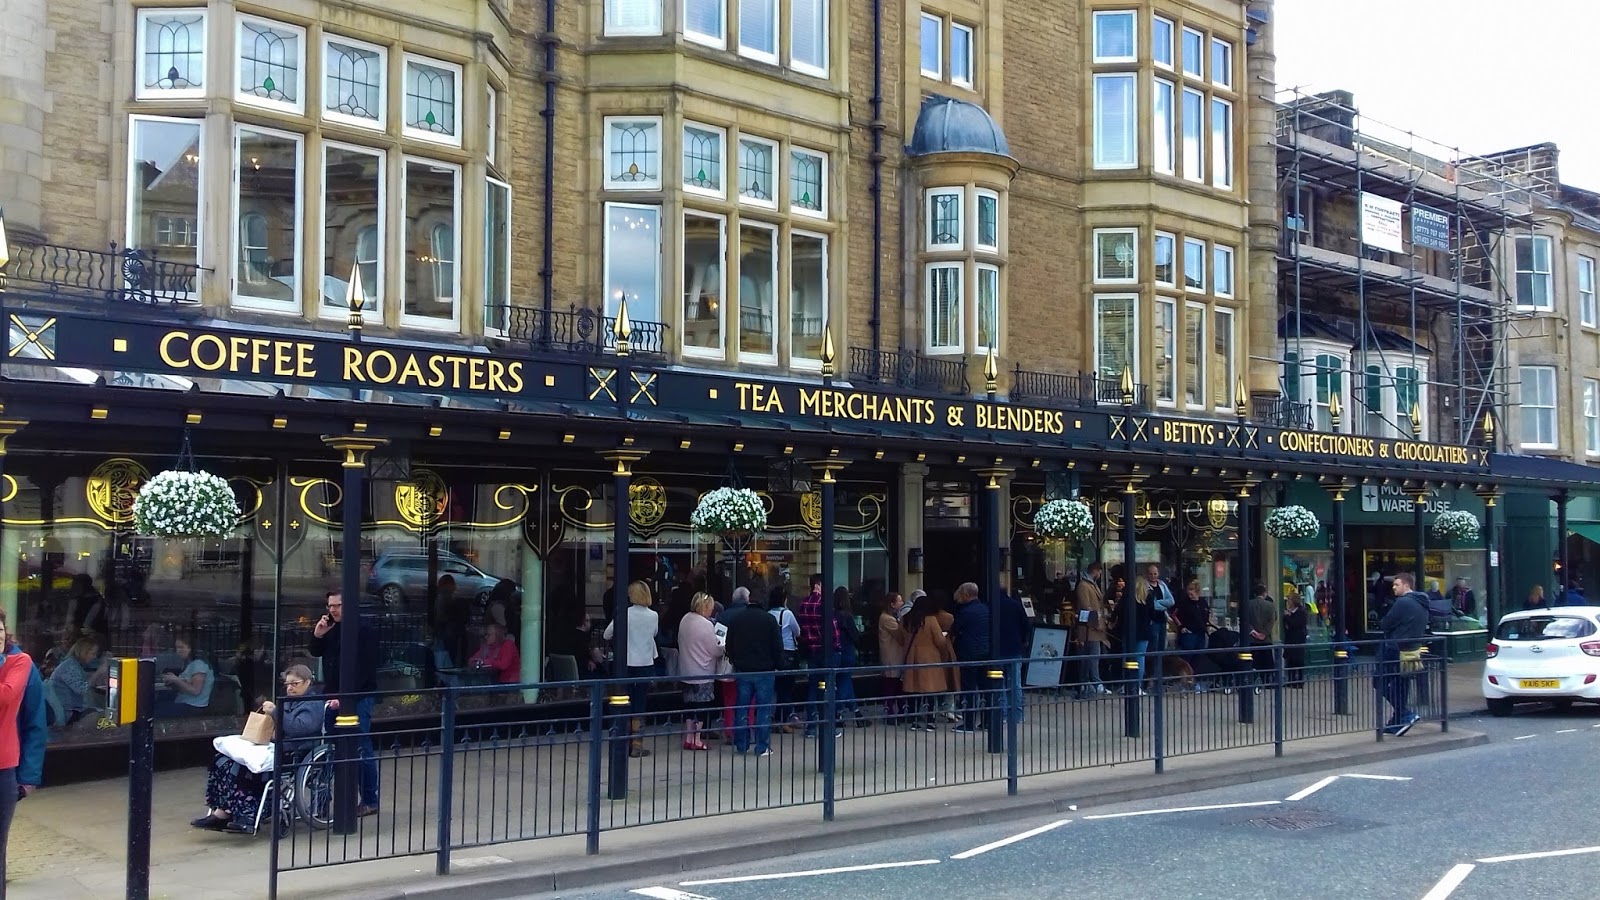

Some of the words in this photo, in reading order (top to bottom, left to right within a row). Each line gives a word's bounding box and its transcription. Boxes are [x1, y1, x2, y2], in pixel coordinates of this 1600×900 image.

[1413, 207, 1448, 225] PREMIER
[159, 331, 316, 377] COFFEE
[343, 347, 523, 393] ROASTERS
[735, 382, 783, 413] TEA
[799, 388, 935, 426] MERCHANTS
[947, 405, 964, 426] &
[975, 404, 1064, 434] BLENDERS
[1163, 421, 1214, 445] BETTYS
[1279, 431, 1374, 458] CONFECTIONERS
[1379, 443, 1389, 458] &
[1394, 441, 1468, 464] CHOCOLATIERS
[1380, 498, 1451, 513] WAREOUSE
[1523, 680, 1540, 688] YA16
[1540, 680, 1556, 688] SKF
